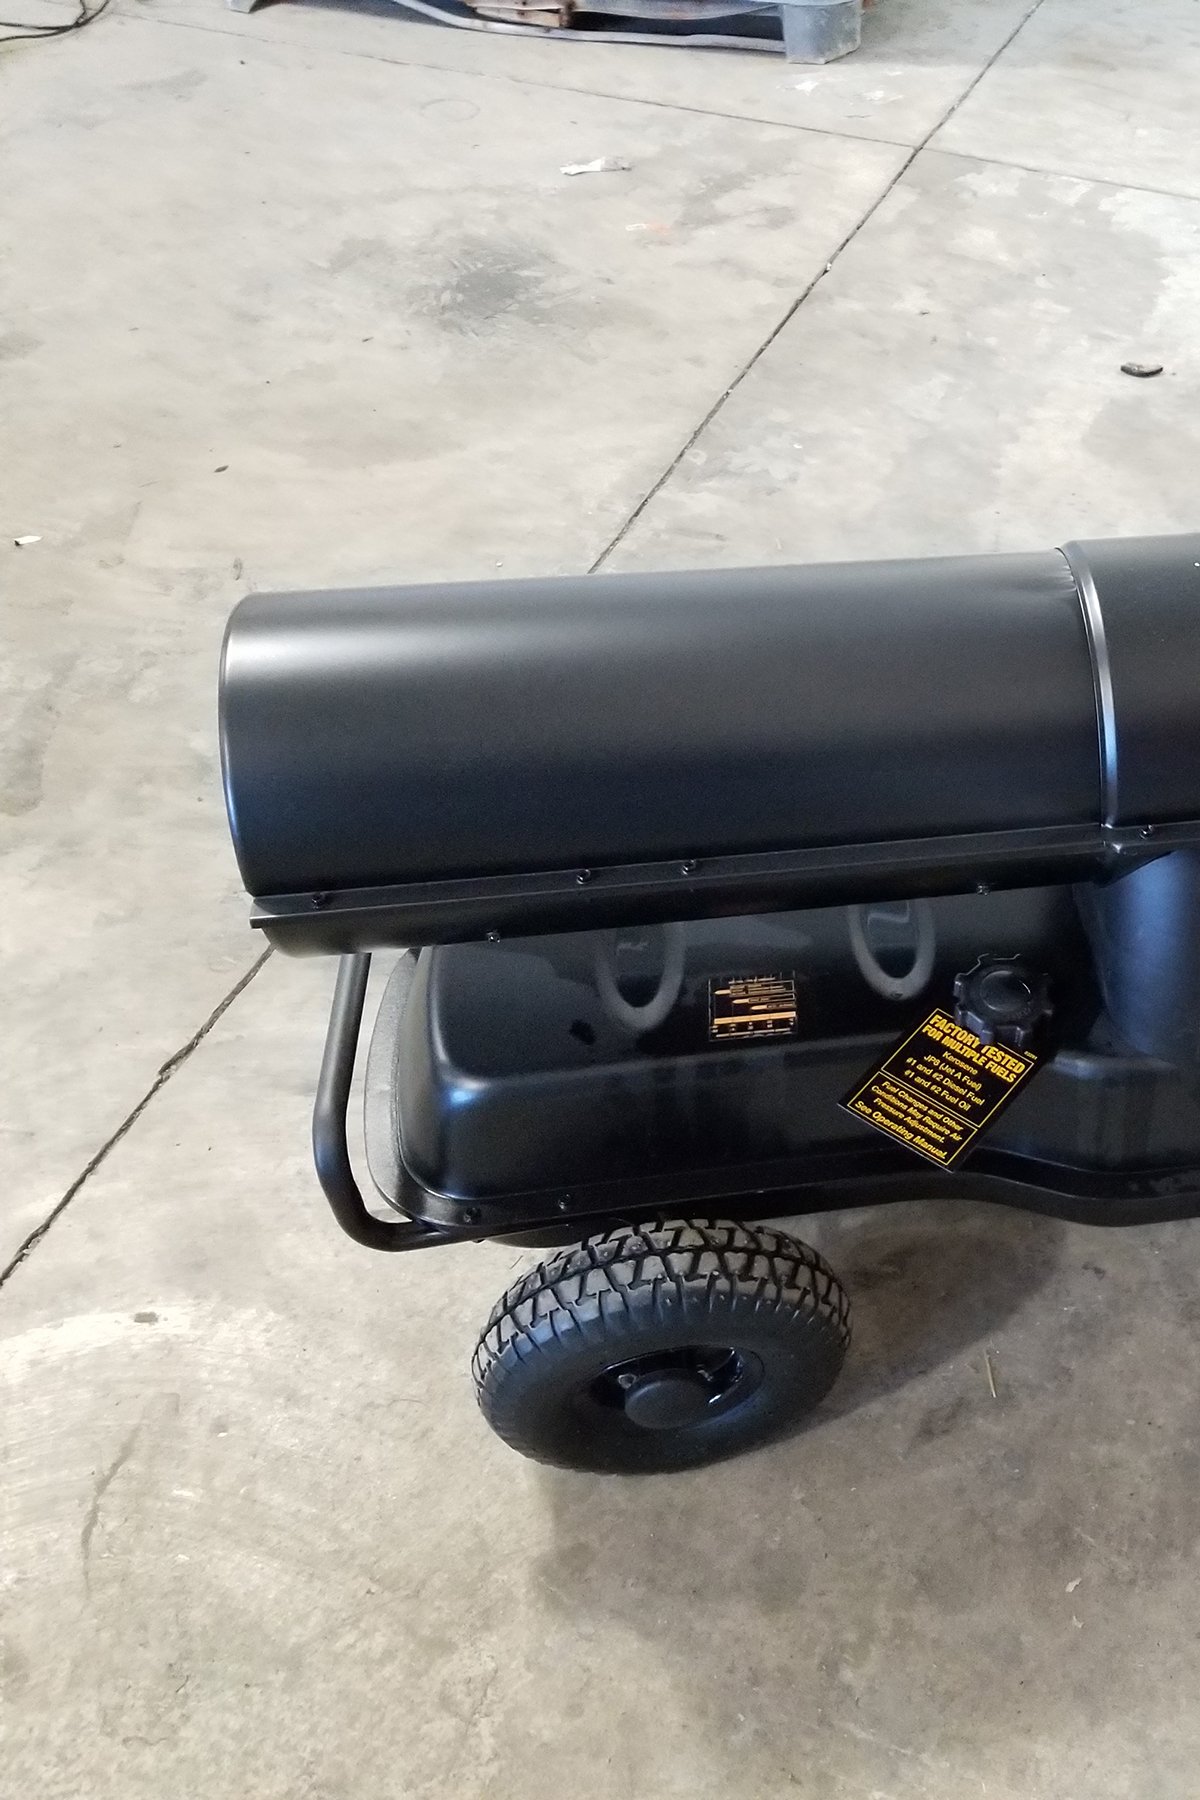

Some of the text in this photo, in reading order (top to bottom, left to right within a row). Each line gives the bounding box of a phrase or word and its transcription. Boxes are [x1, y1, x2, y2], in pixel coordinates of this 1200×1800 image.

[922, 1024, 1017, 1083] FOR MULTIPLE FUELS
[930, 1014, 1026, 1073] FACTORY TESTED
[942, 1051, 978, 1075] Kerosene
[881, 1081, 963, 1131] Fuel Changes and Other
[914, 1076, 931, 1088] and
[930, 1085, 942, 1094] #2
[940, 1090, 959, 1104] Fuel
[958, 1101, 971, 1111] Oil
[916, 1064, 933, 1075] and
[932, 1072, 943, 1081] #2
[942, 1077, 967, 1095] Diesel
[966, 1091, 985, 1106] Fuel
[961, 1075, 982, 1091] Fuel)
[855, 1101, 947, 1159] See Operating Manual.
[871, 1085, 962, 1141] Conditions May Require Air
[873, 1097, 905, 1119] Pressure
